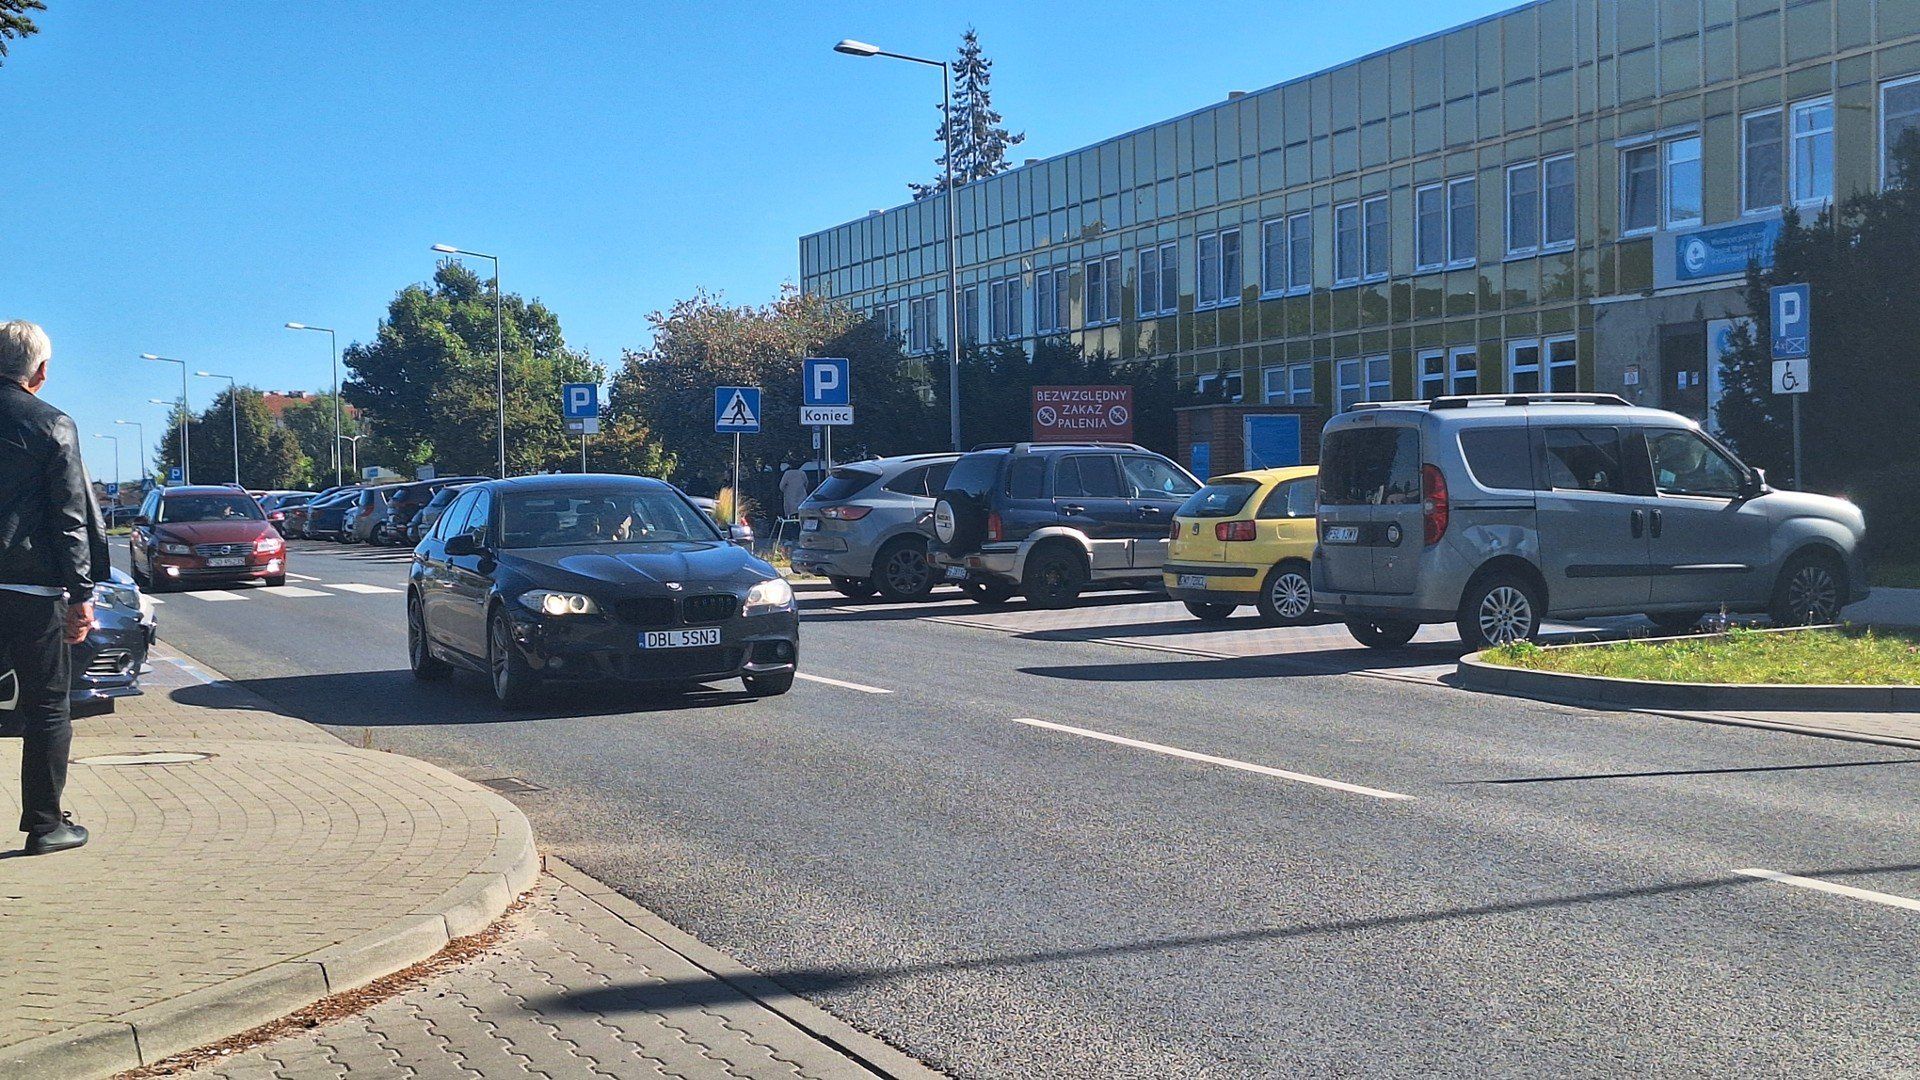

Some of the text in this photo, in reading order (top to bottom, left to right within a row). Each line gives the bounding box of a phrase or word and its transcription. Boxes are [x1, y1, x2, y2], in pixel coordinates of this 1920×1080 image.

[1779, 292, 1800, 337] P
[813, 364, 839, 400] P
[570, 387, 590, 414] P
[1036, 390, 1127, 403] BEZWZGLĘDNY
[805, 409, 848, 421] Koniec
[1062, 404, 1103, 415] ZAKAZ
[1058, 418, 1108, 429] PALENIA
[171, 468, 180, 479] P
[108, 484, 116, 493] P
[648, 630, 717, 647] DBL 5SN3
